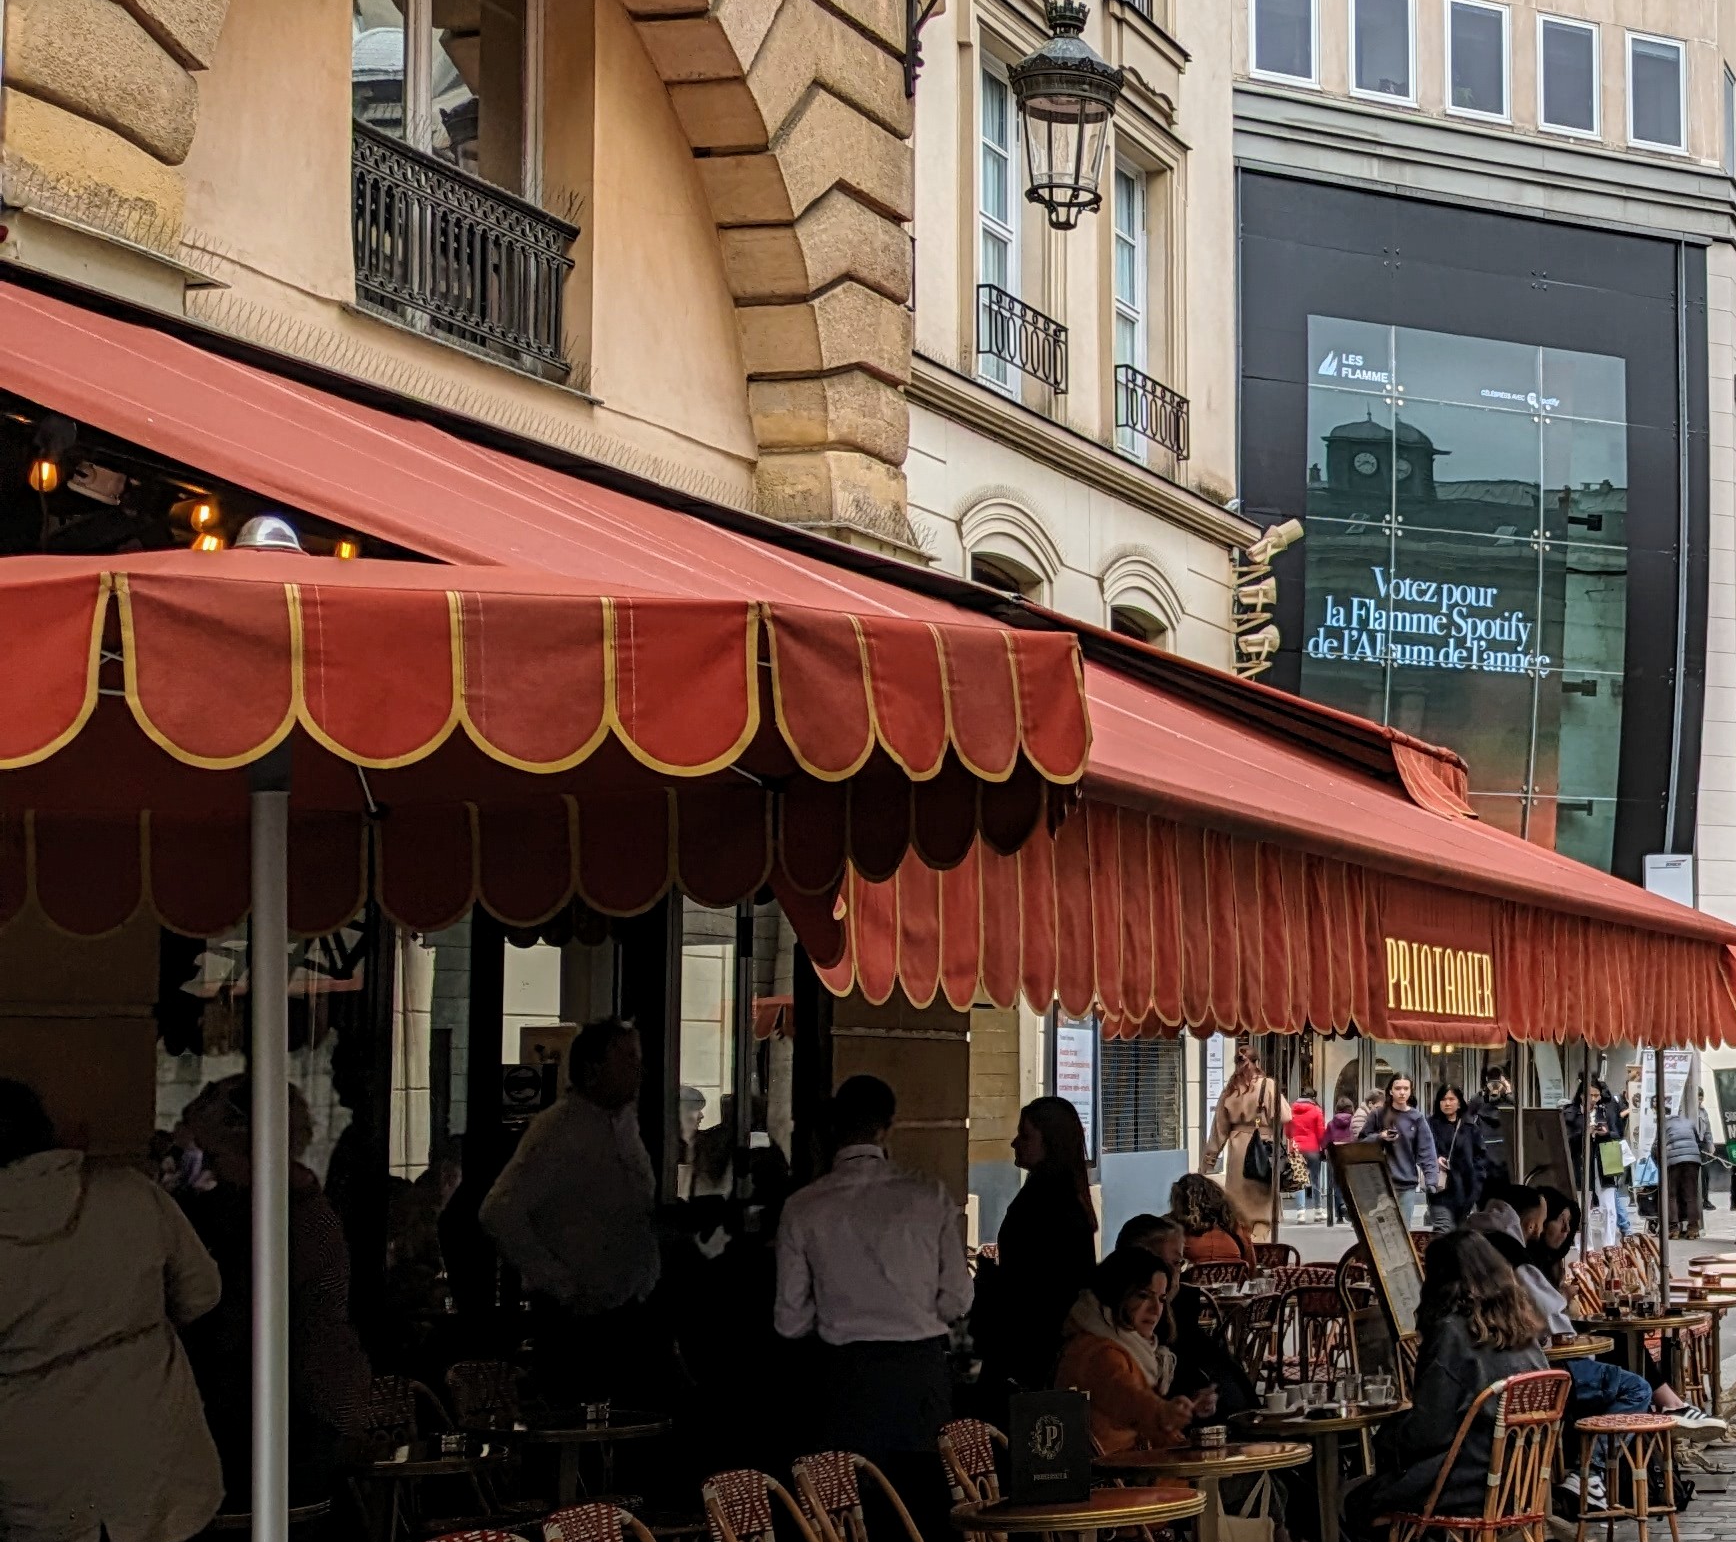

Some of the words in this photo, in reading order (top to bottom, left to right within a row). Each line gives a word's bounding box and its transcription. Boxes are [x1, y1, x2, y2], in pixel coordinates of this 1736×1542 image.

[1341, 353, 1364, 366] LES
[1341, 367, 1395, 383] FLAMME
[1371, 566, 1438, 603] Votez
[1440, 583, 1498, 614] pour
[1324, 595, 1347, 628] la
[1349, 597, 1448, 636] Flamme
[1451, 606, 1533, 651] Spotify
[1307, 628, 1338, 659] de
[1438, 637, 1468, 669] de
[1385, 938, 1494, 1018] PRINTANIER
